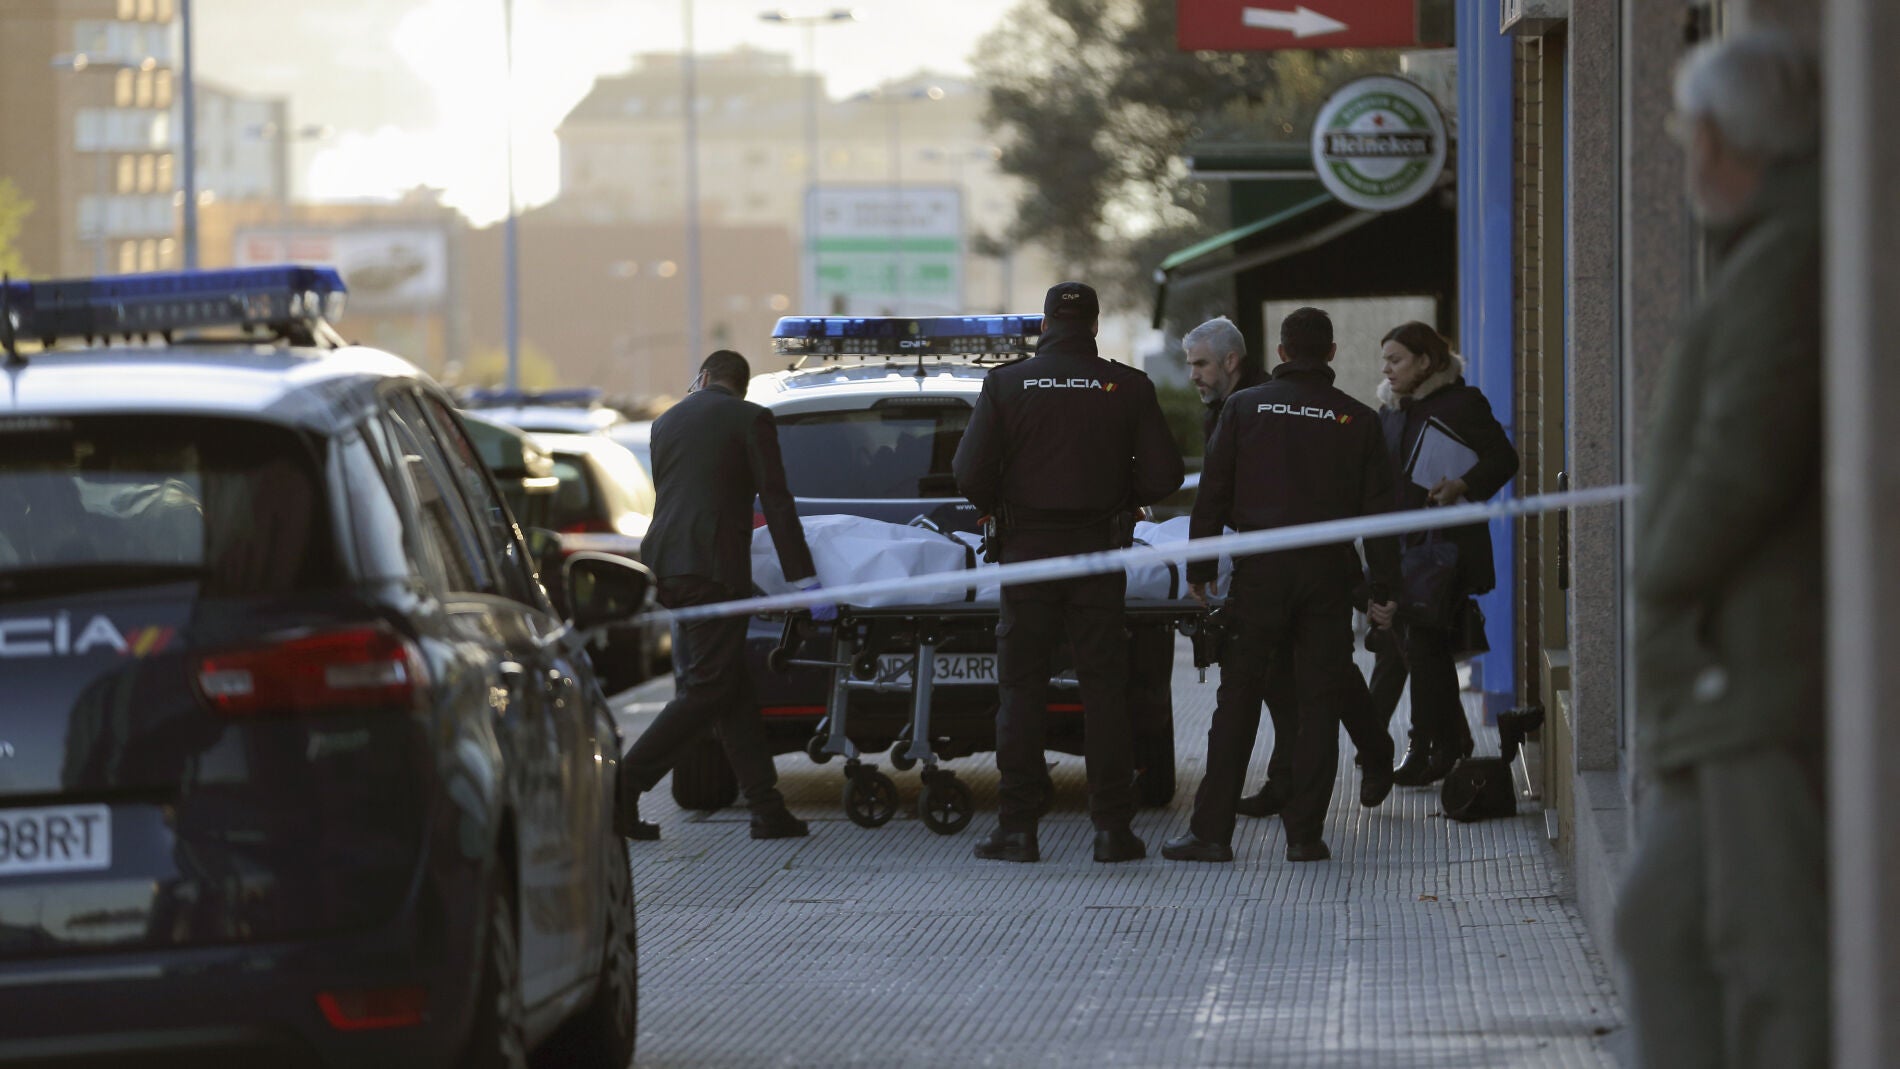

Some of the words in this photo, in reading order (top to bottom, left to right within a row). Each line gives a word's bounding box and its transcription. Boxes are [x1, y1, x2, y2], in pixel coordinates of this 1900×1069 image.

[1331, 134, 1426, 156] Heineken
[1023, 378, 1102, 390] POLICIA
[1257, 403, 1337, 420] POLICIA
